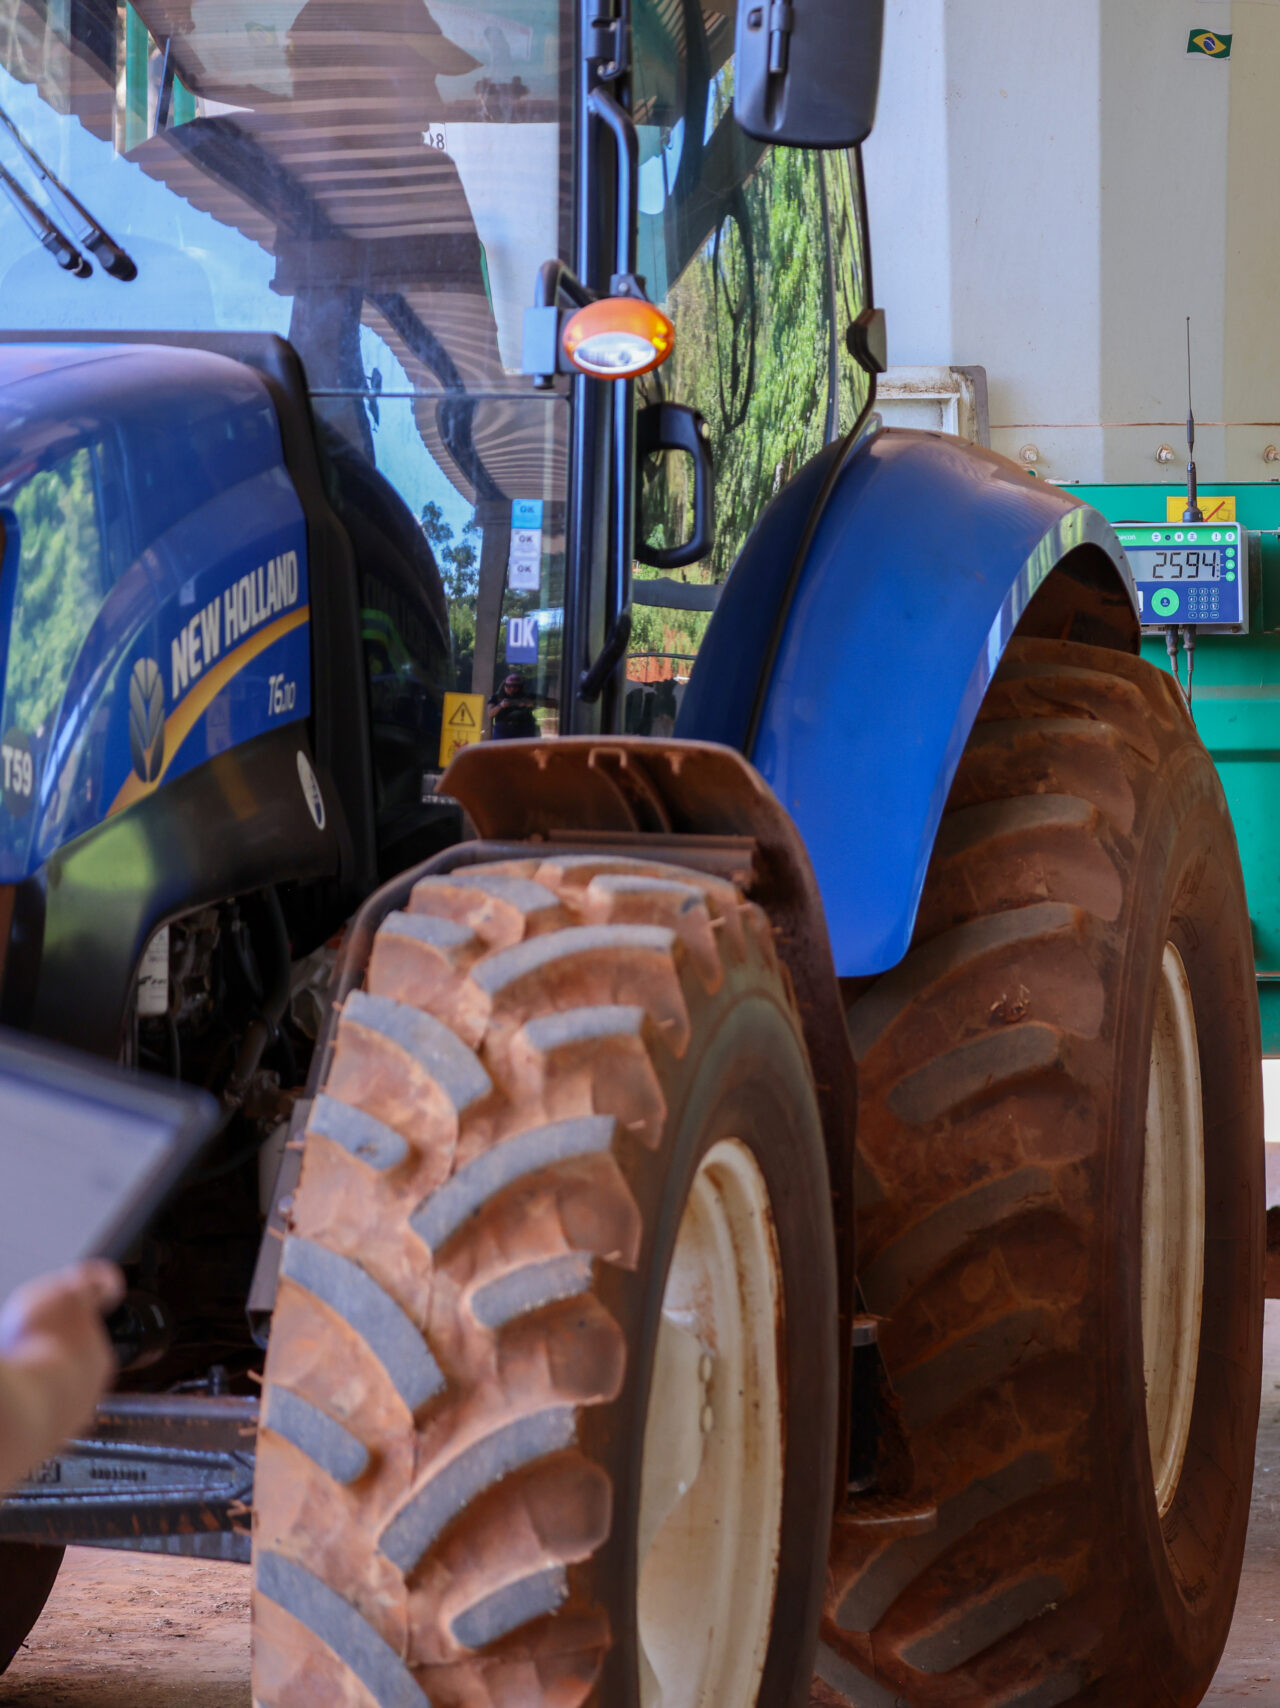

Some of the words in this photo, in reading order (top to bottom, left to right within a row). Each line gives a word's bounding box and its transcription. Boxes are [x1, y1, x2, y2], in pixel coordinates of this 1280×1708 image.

[520, 505, 535, 513] OK
[519, 535, 533, 543] OK
[517, 565, 532, 573] OK
[1152, 552, 1217, 578] 2594
[171, 596, 221, 701] NEW
[224, 550, 298, 647] HOLLAND
[510, 617, 536, 647] OK
[2, 744, 33, 797] T59
